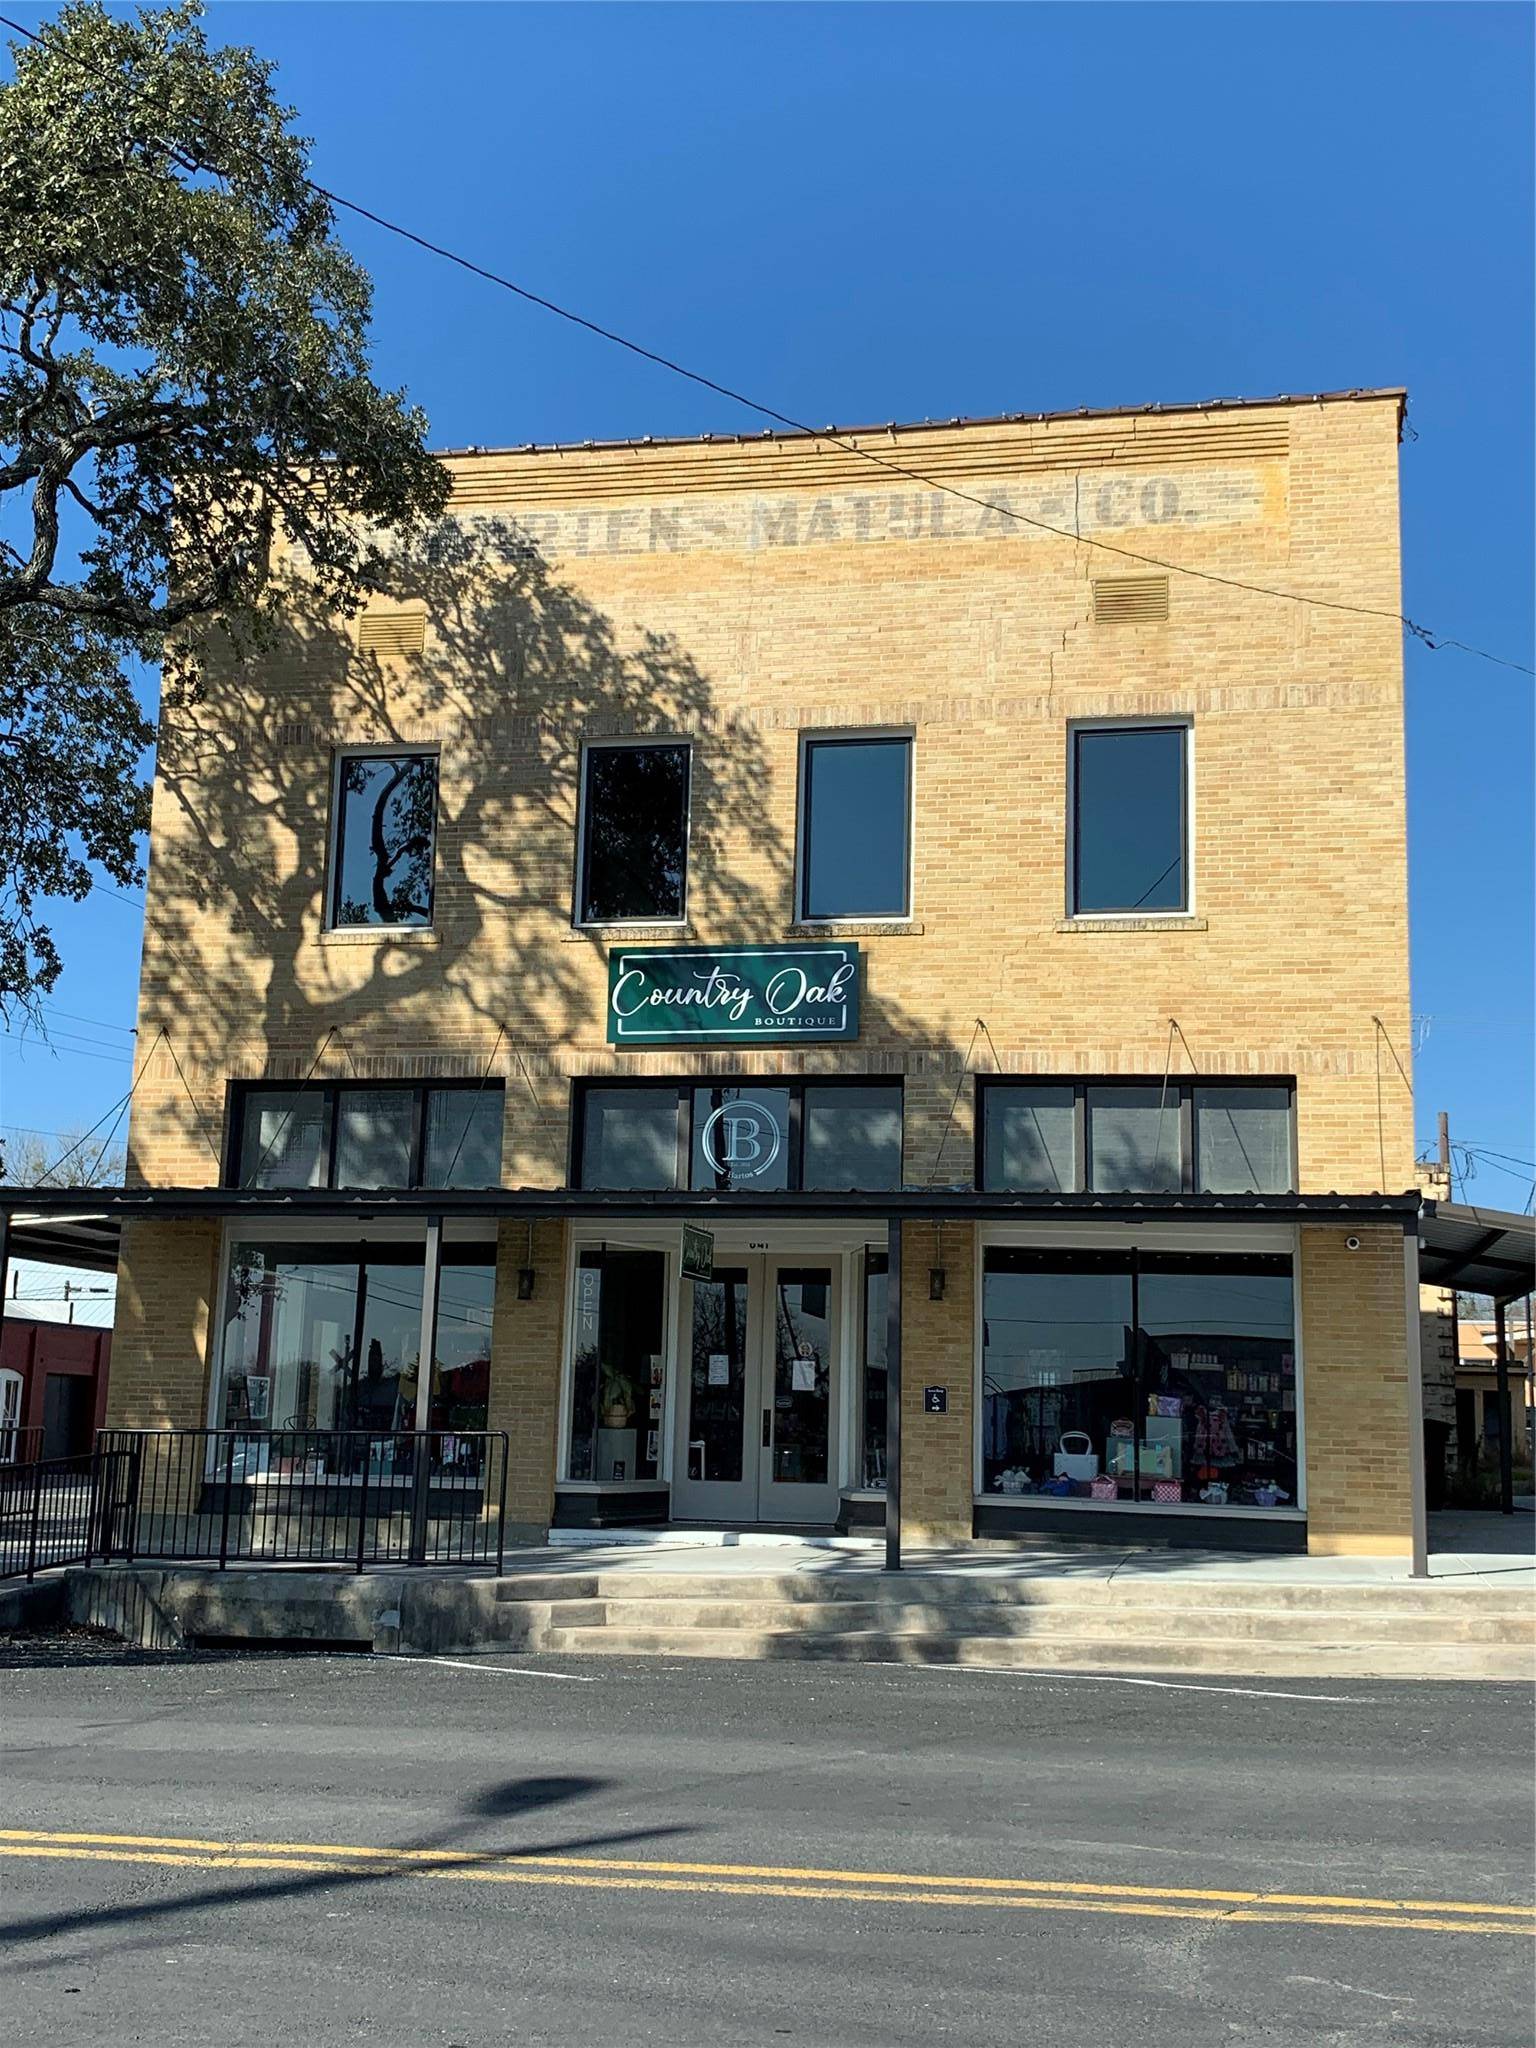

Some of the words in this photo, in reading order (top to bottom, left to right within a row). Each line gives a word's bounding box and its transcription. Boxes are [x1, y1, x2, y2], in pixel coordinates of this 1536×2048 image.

[612, 965, 753, 1021] Country
[766, 963, 855, 1015] Oak
[755, 1017, 836, 1026] BOUTIQUE
[722, 1117, 761, 1161] B
[583, 1273, 594, 1331] OPEN
